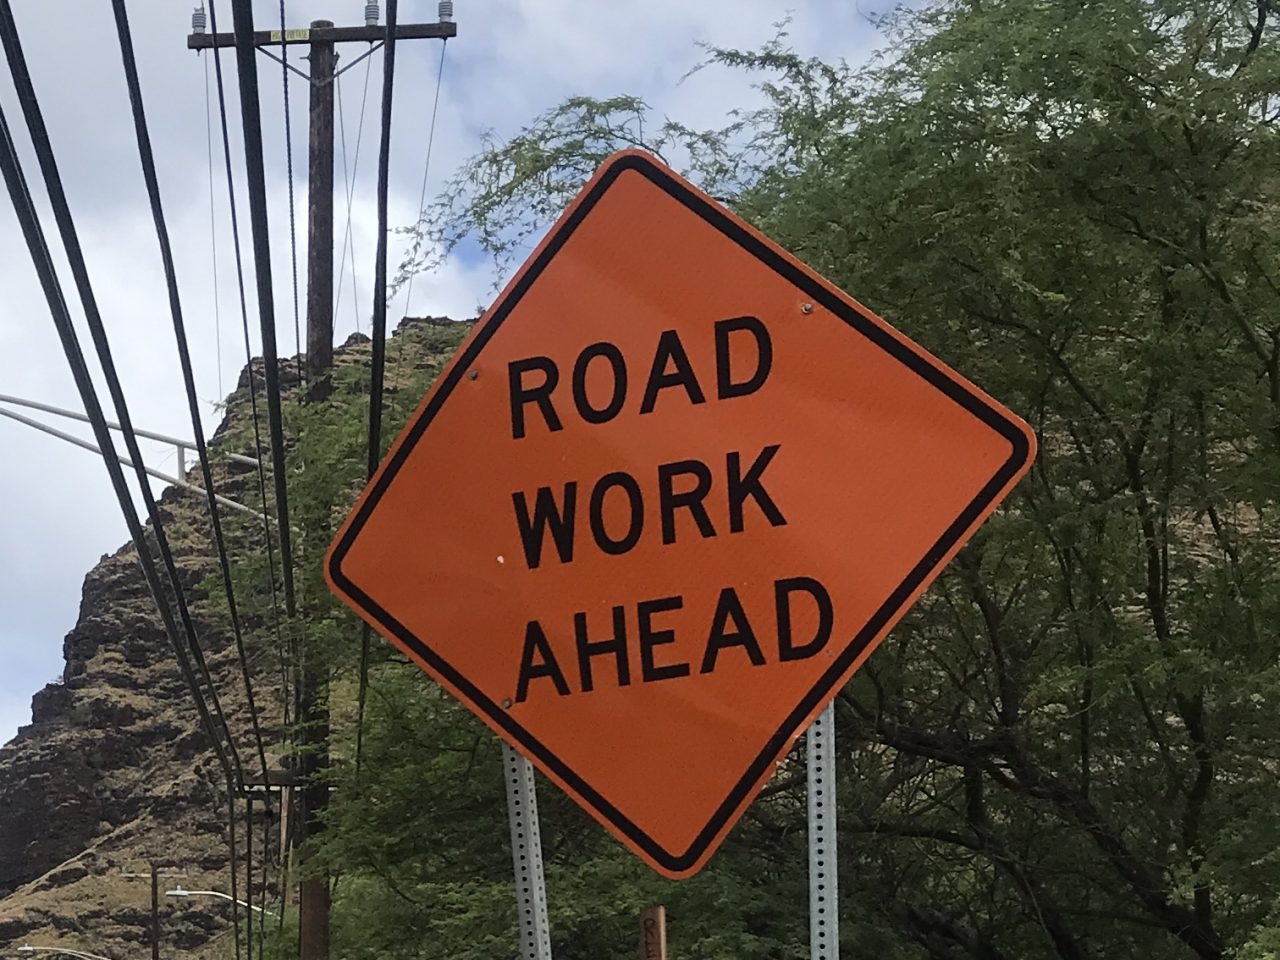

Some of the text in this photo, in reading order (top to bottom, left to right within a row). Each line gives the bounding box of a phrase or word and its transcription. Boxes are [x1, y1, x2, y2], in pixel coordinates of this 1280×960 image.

[508, 316, 773, 440] ROAD
[511, 444, 787, 570] WORK
[515, 576, 834, 703] AHEAD
